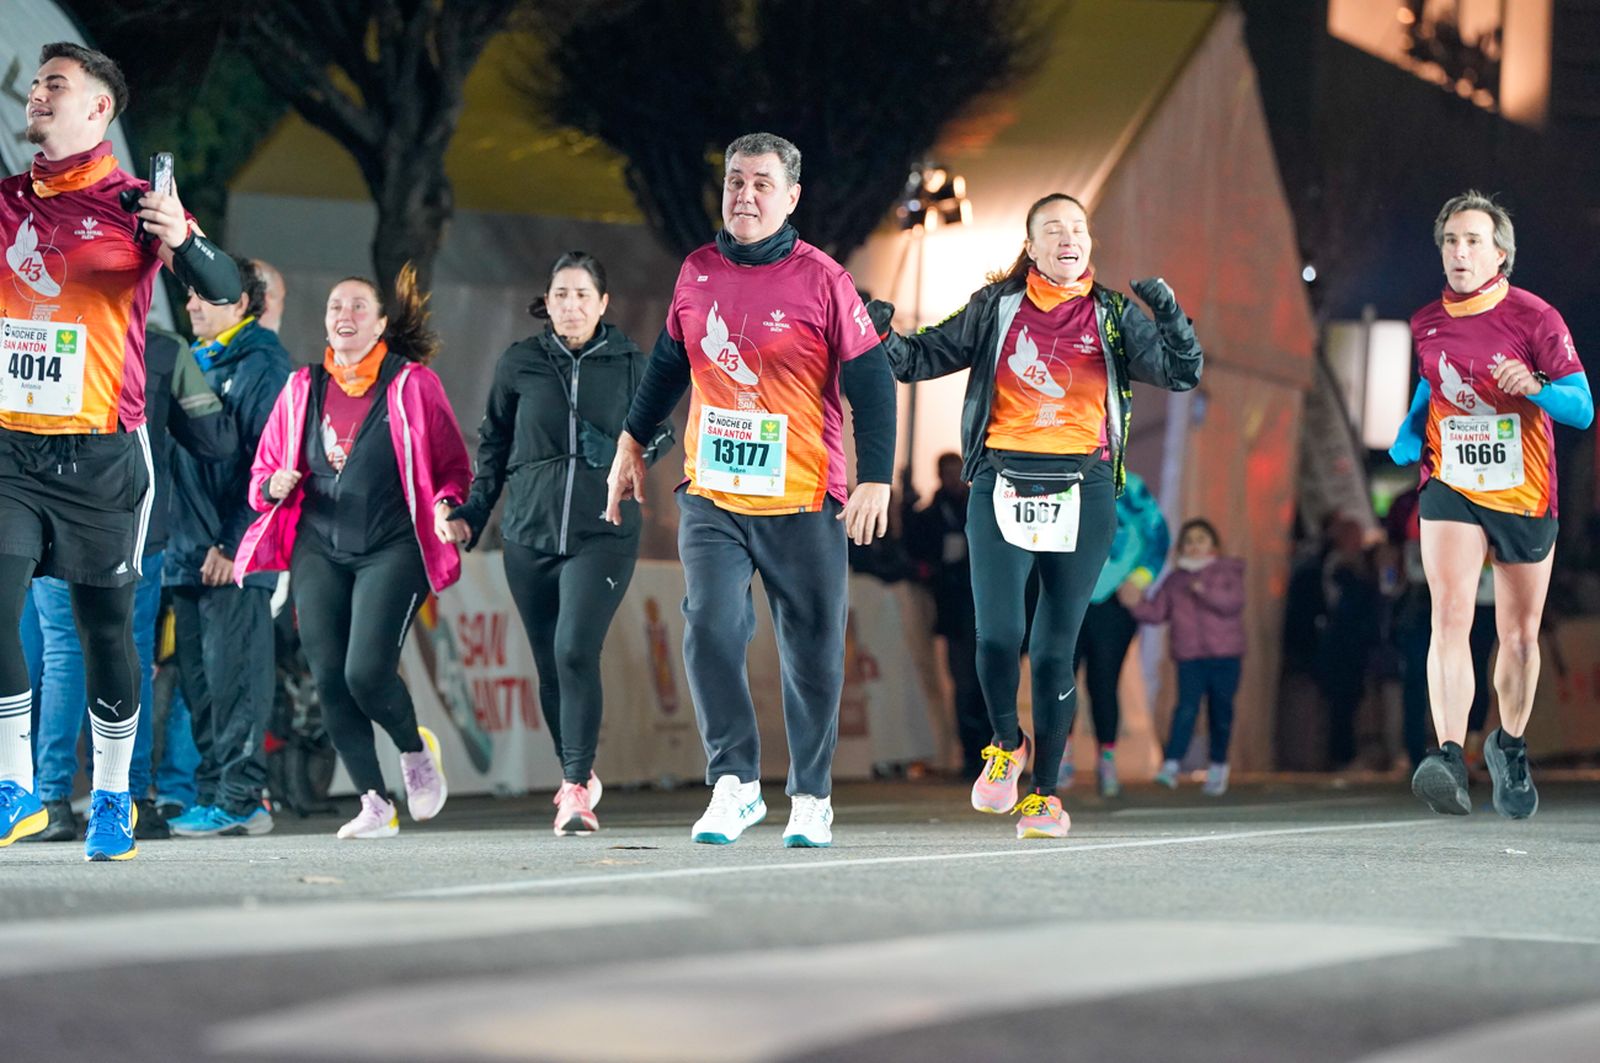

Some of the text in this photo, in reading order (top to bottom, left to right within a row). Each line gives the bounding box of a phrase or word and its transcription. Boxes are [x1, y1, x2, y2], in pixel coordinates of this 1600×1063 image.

[18, 257, 42, 282] 43
[4, 340, 16, 350] SAN
[12, 330, 47, 341] NOCHE DE
[8, 352, 62, 382] 4014
[717, 348, 739, 372] 43
[1023, 365, 1047, 385] 43
[1456, 390, 1476, 409] 43
[707, 426, 722, 436] SAN
[716, 418, 752, 430] NOCHE DE
[1480, 423, 1489, 431] DE
[712, 438, 769, 467] 13177
[1456, 443, 1506, 465] 1666
[1012, 501, 1061, 523] 1667
